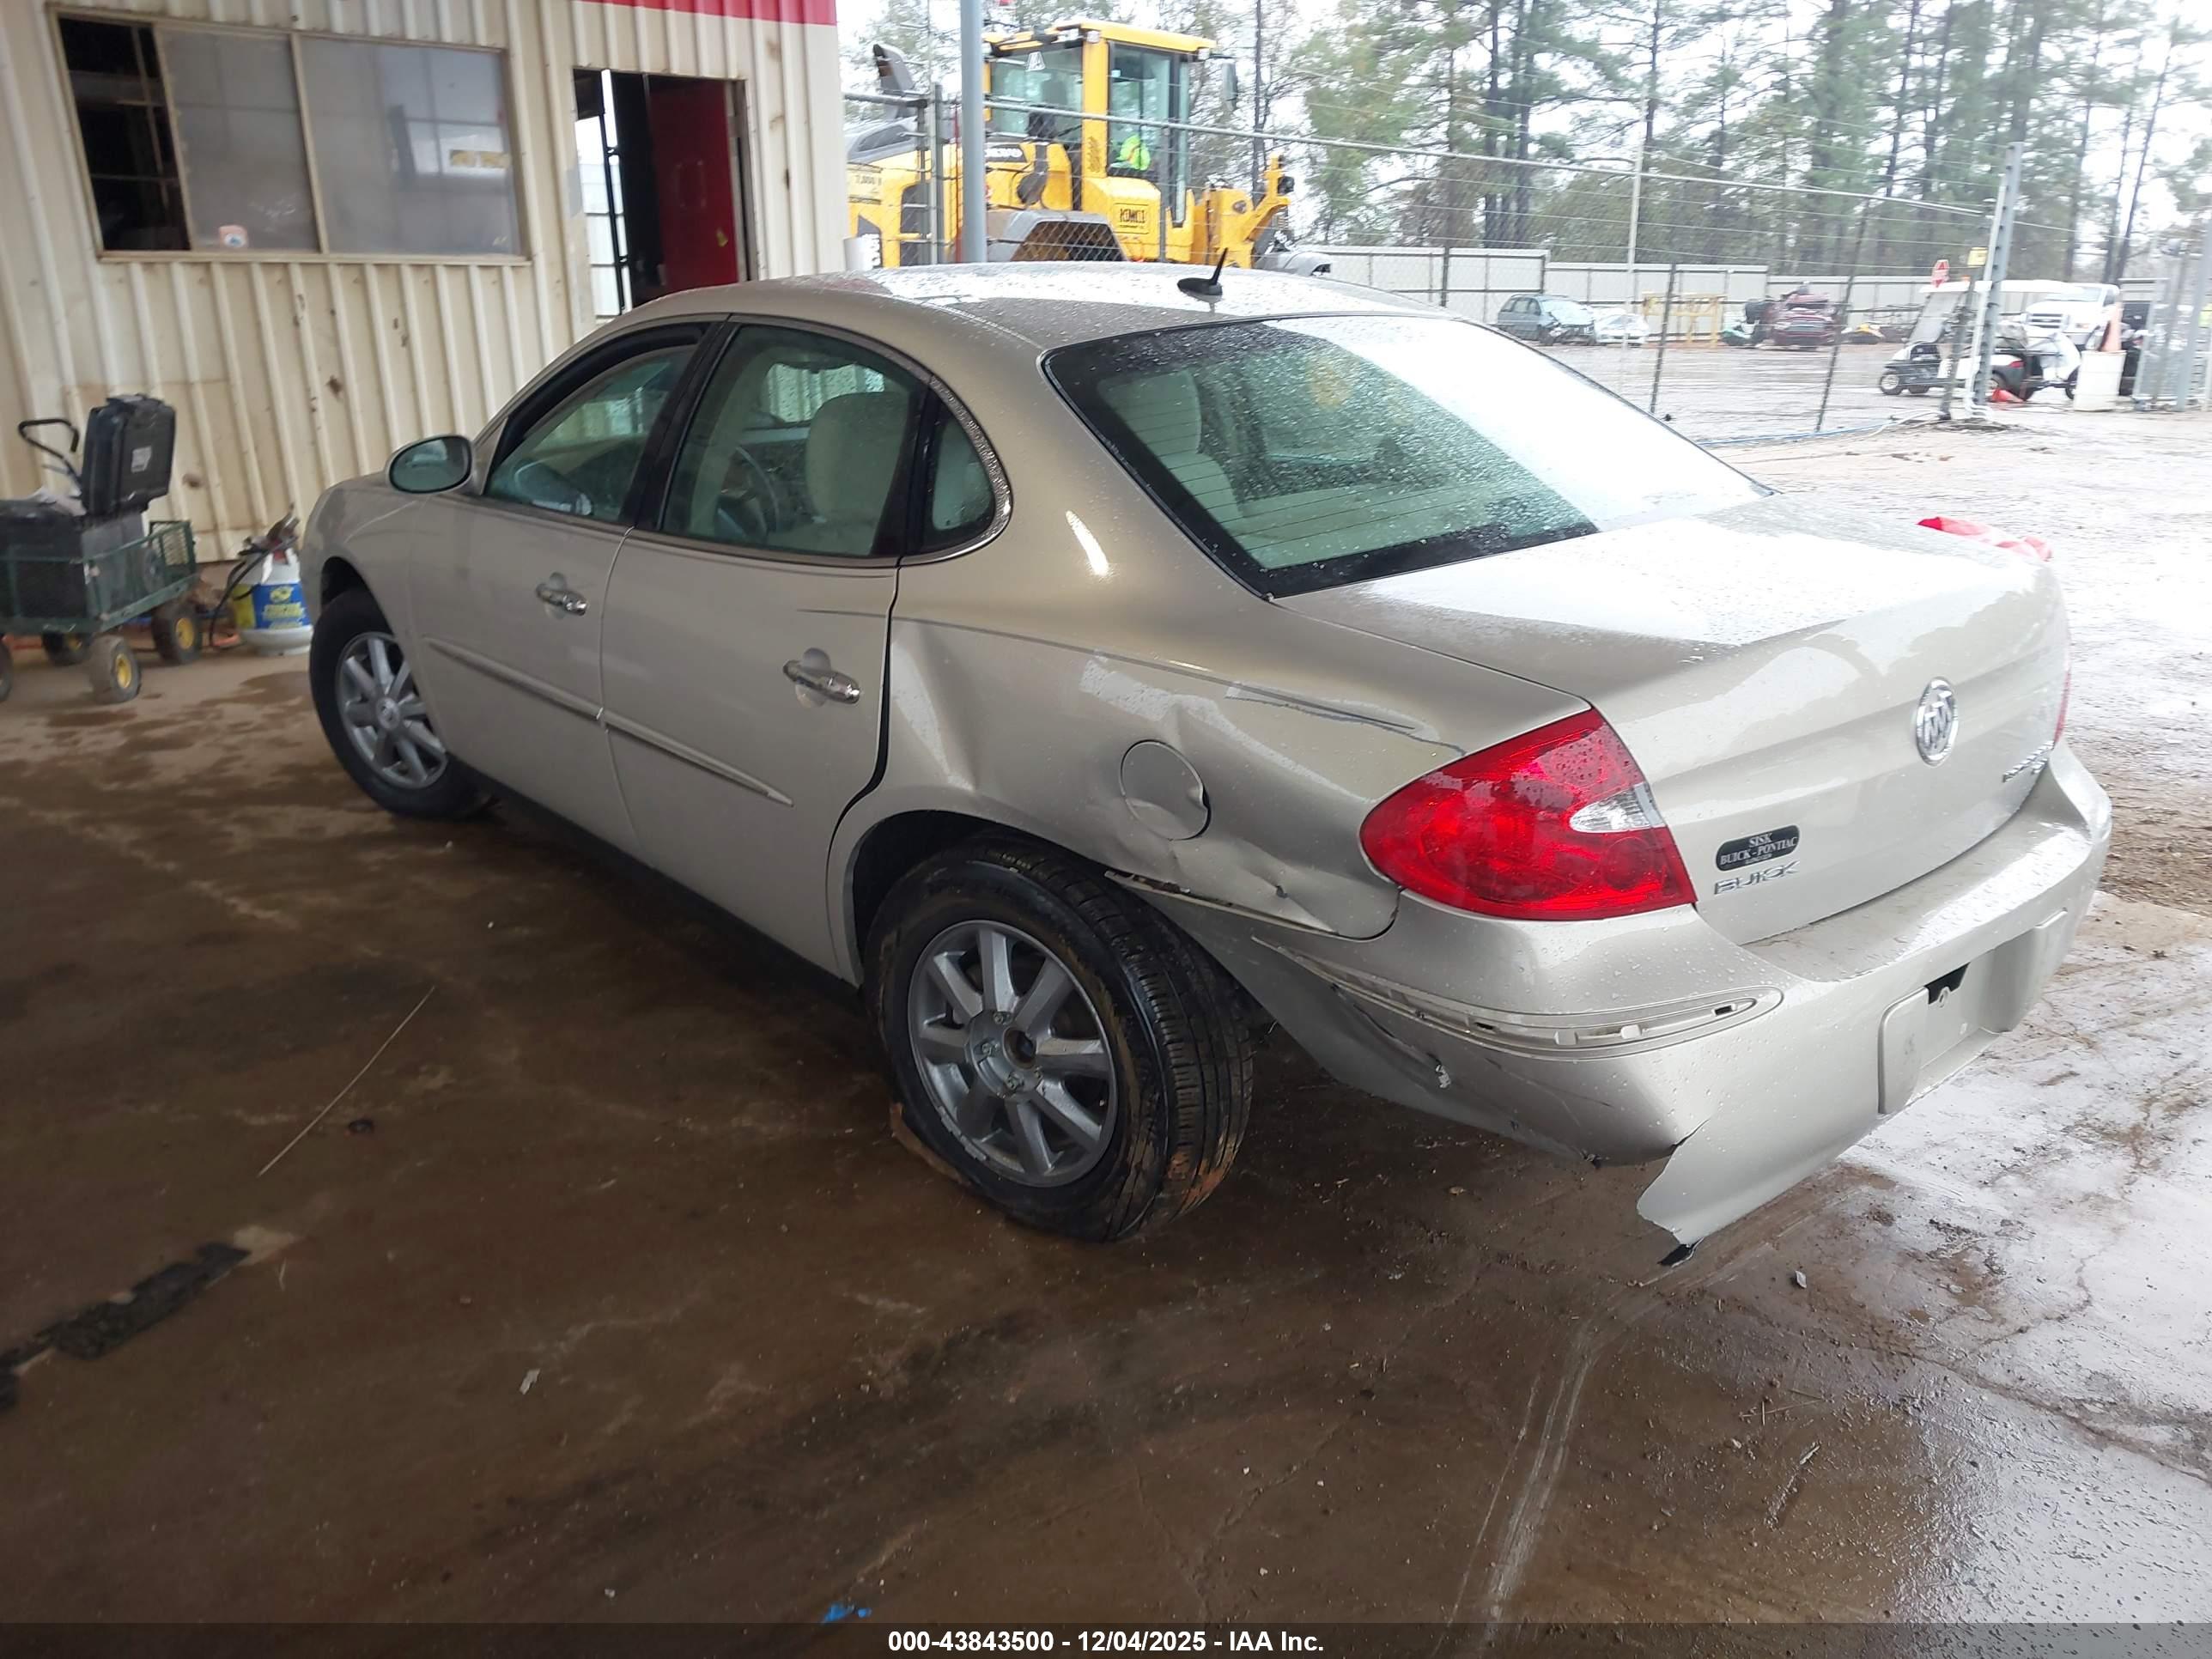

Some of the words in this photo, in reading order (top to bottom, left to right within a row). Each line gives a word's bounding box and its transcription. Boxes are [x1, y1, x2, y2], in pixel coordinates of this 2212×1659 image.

[1720, 848, 1752, 866] BUICK
[1757, 836, 1798, 856] PONTIAC
[1748, 832, 1772, 848] SISK
[1714, 860, 1801, 895] BUICK
